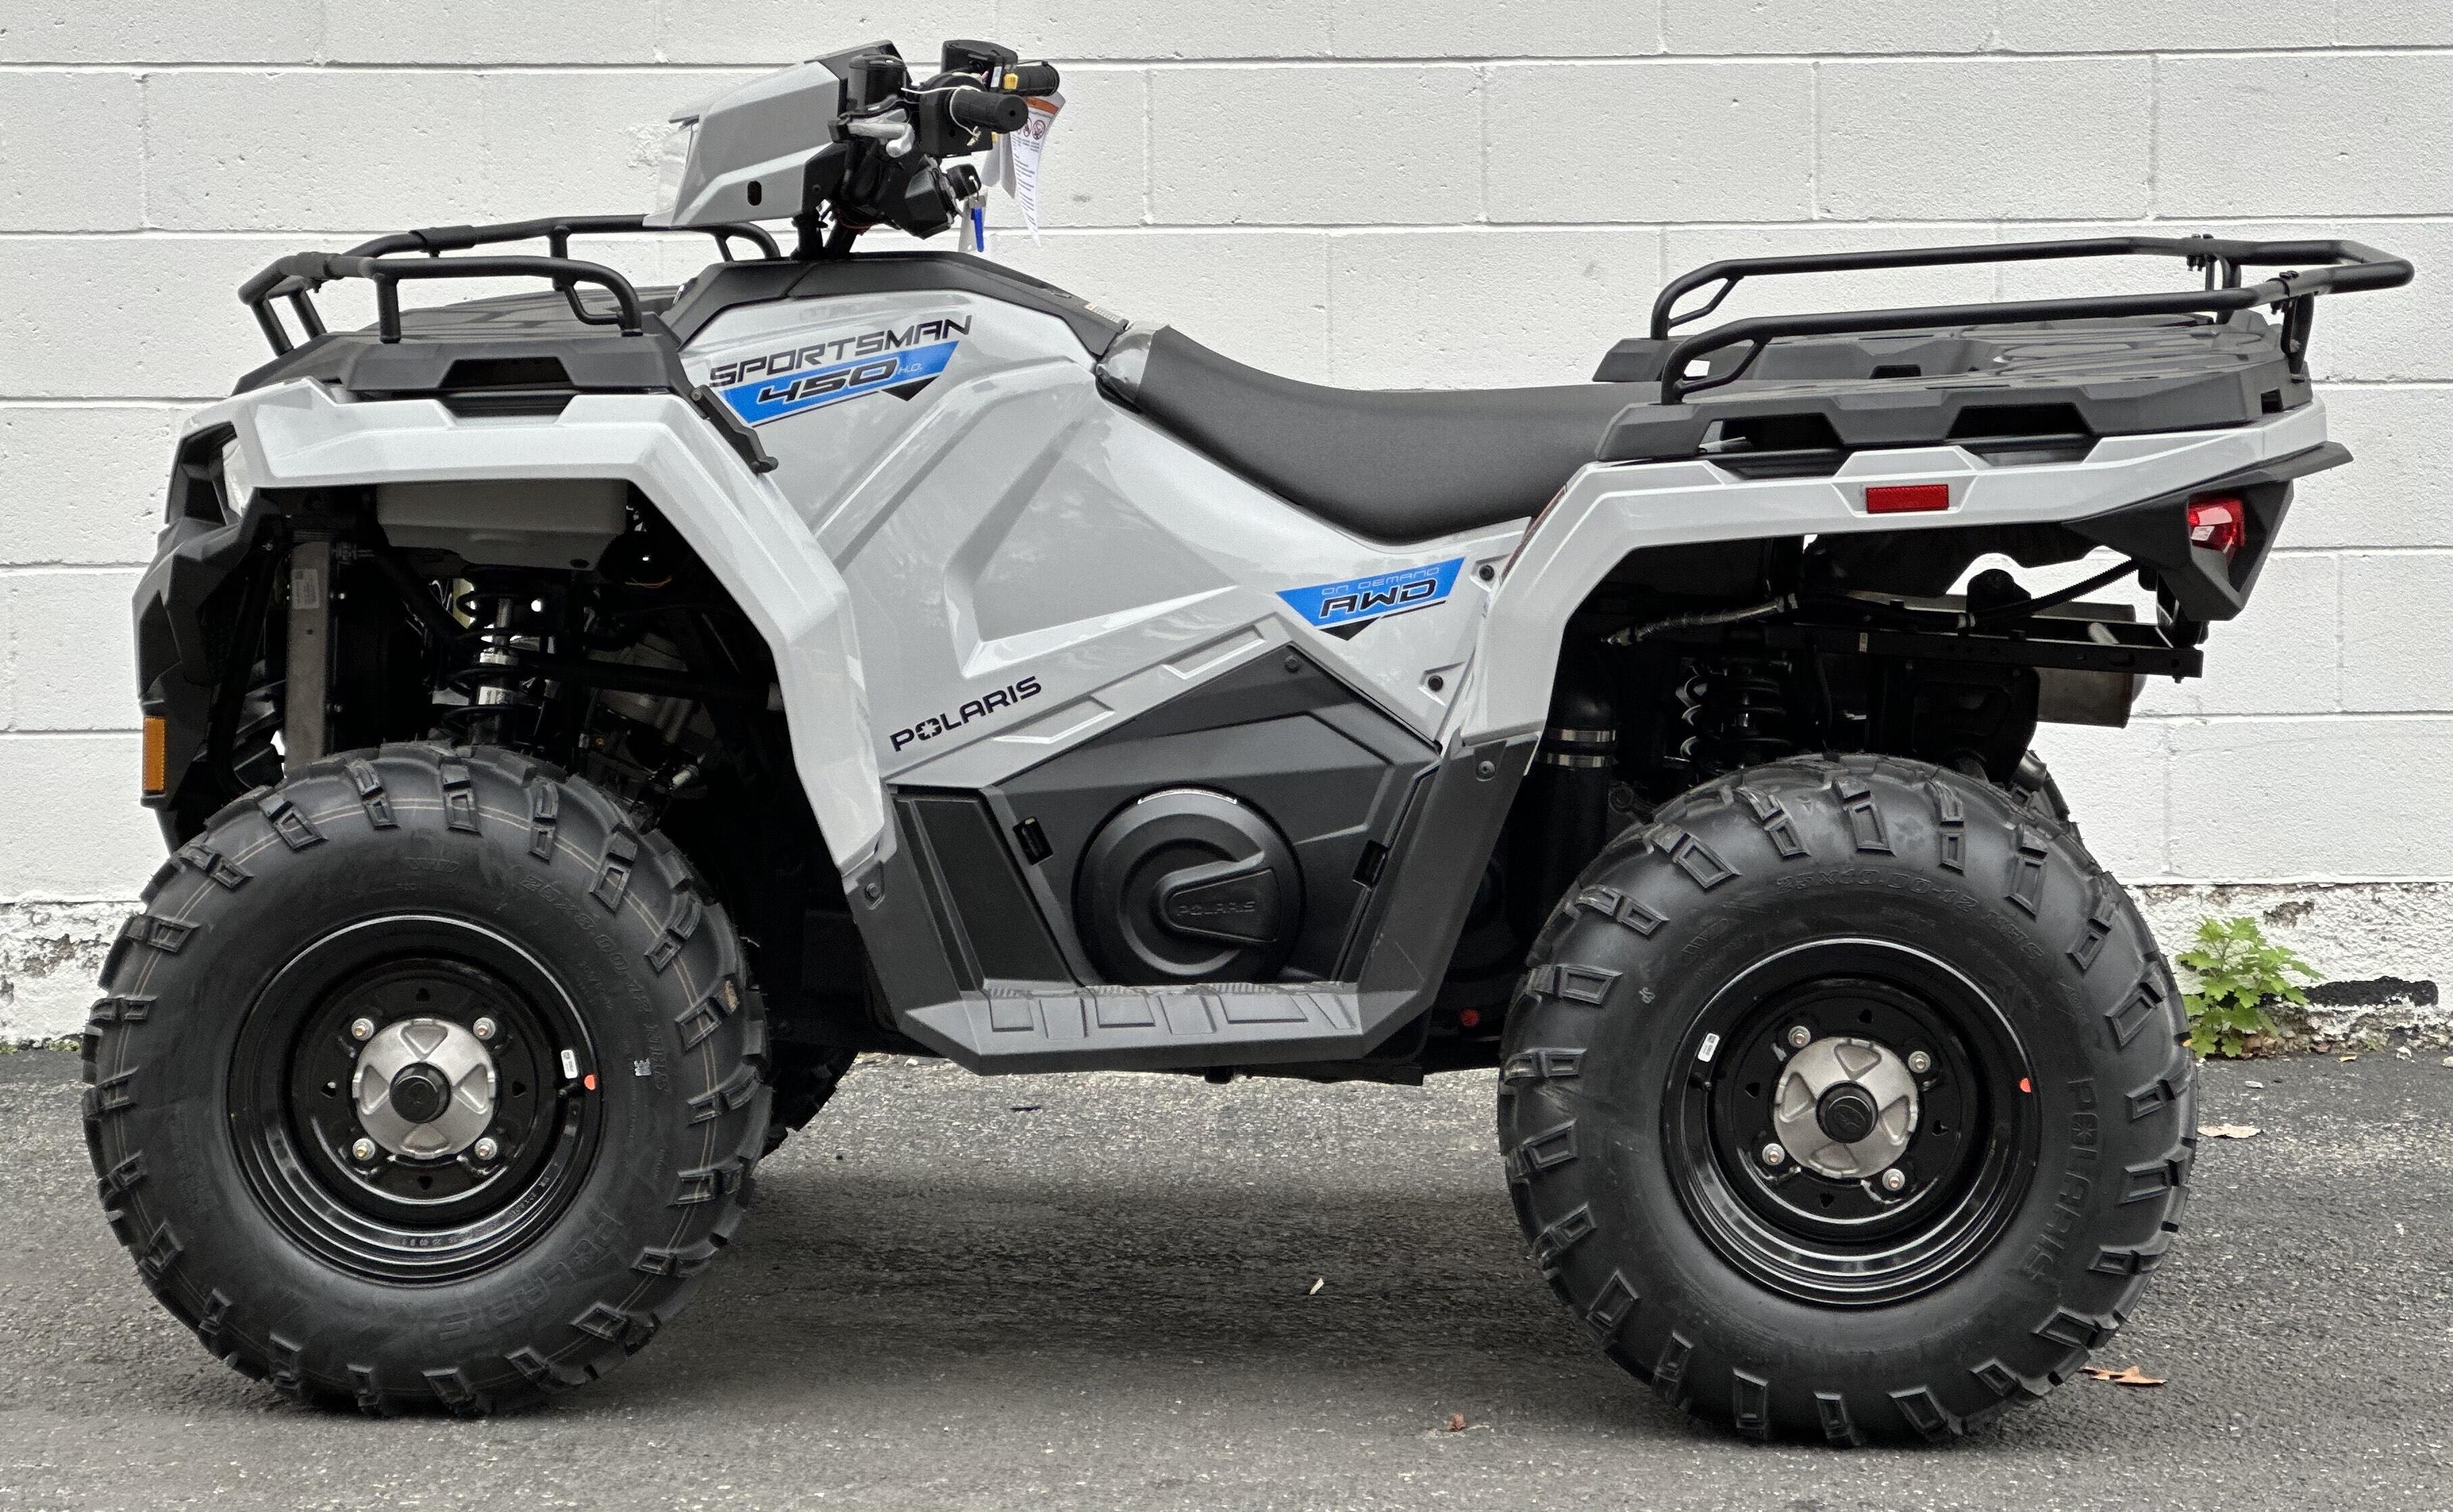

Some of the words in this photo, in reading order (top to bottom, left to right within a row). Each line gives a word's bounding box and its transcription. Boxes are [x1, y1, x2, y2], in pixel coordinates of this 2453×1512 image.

[709, 315, 972, 387] SPORTSMAN
[757, 357, 899, 403] 450
[1319, 578, 1438, 619] AWD
[1358, 567, 1440, 589] DEMAND
[889, 676, 1041, 752] POLARIS
[1176, 900, 1256, 917] POLARIS
[2026, 1077, 2099, 1282] POLARIS
